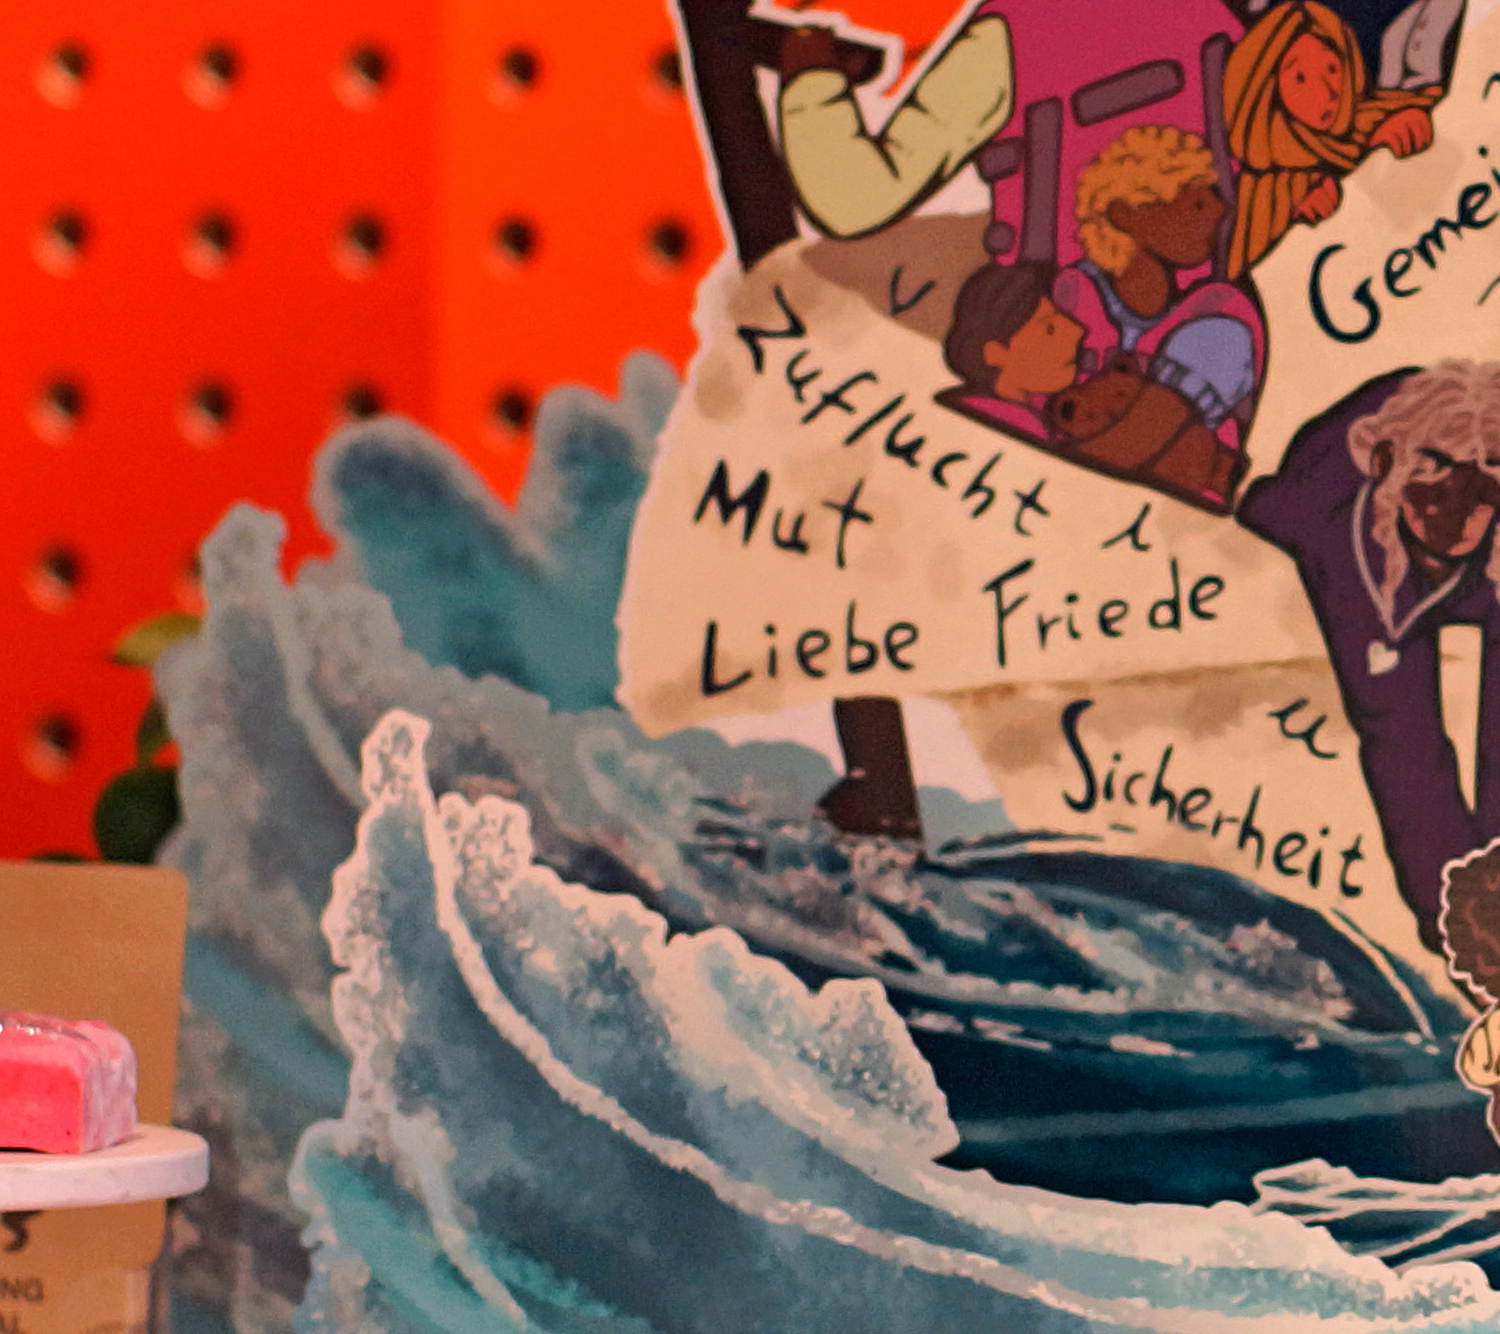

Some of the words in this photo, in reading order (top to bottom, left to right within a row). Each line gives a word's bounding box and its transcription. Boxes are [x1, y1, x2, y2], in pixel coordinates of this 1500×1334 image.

[738, 284, 1051, 536] Zuflucht
[694, 461, 873, 568] Mut
[699, 600, 919, 697] Liebe
[983, 557, 1226, 668] Friede
[1061, 699, 1364, 898] Sicherheit
